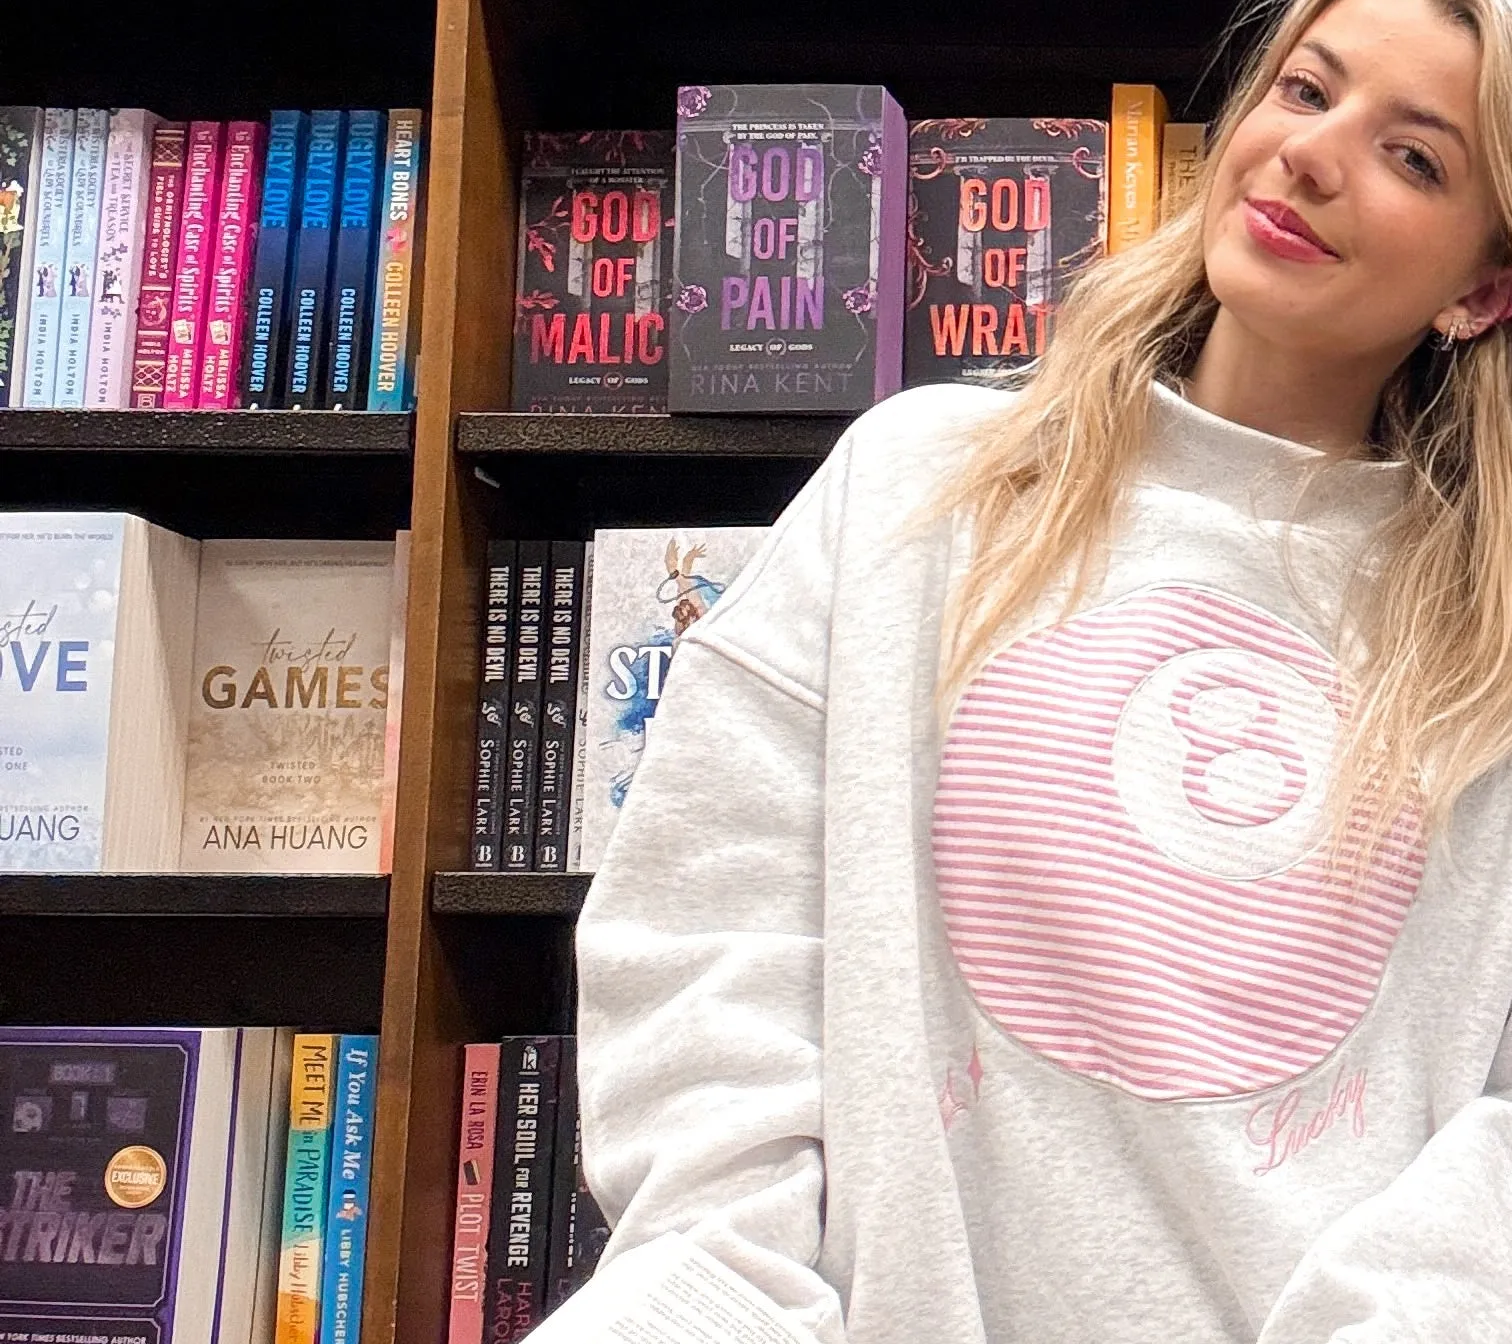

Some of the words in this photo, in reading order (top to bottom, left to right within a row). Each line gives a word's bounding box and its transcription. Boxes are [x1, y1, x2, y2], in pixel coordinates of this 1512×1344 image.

[394, 120, 414, 168] HEART
[390, 171, 410, 221] BONES
[730, 146, 825, 202] GOD
[752, 218, 797, 261] OF
[382, 262, 403, 330] COLLEEN
[720, 276, 826, 331] PAIN
[377, 331, 399, 392] HOOVER
[729, 341, 764, 353] LEGACY
[788, 342, 813, 352] GODS
[554, 567, 574, 606] THERE
[552, 627, 571, 646] NO
[554, 609, 572, 623] IS
[202, 666, 390, 709] GAMES
[550, 648, 570, 684] DEVIL
[1169, 670, 1308, 828] 8
[203, 825, 262, 850] ANA
[270, 825, 369, 850] HUANG
[519, 1083, 540, 1115] HER
[1245, 1061, 1370, 1177] Lucky
[514, 1118, 537, 1165] SOUL
[459, 1193, 485, 1235] PLOT
[507, 1192, 533, 1269] REVENGE
[454, 1244, 481, 1303] TWIST
